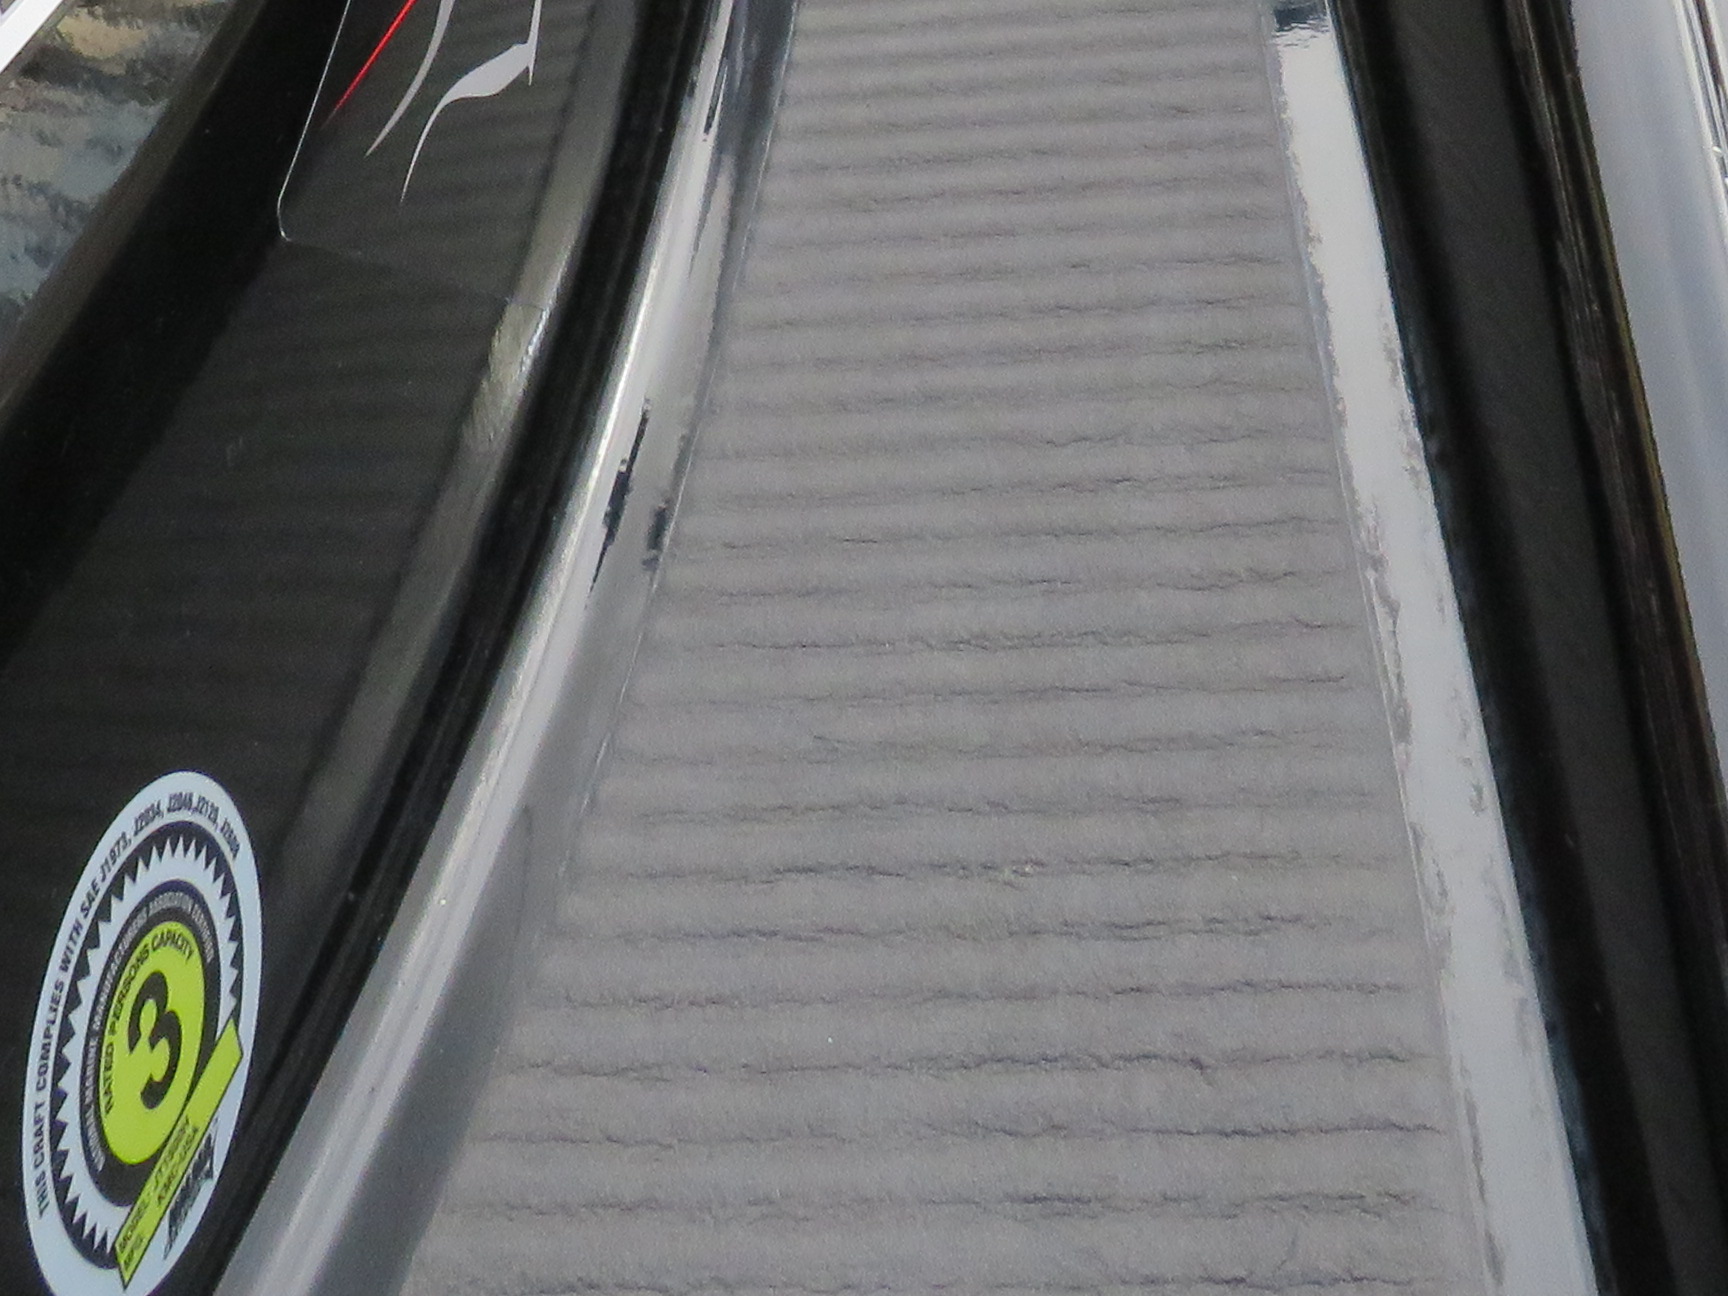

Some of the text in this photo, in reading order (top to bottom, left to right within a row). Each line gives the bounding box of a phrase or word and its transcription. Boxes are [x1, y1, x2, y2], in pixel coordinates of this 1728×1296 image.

[80, 879, 101, 919] SAE
[59, 917, 84, 974] WITH
[35, 979, 65, 1092] COMPLIES
[102, 928, 195, 1117] RATED PERSONS CAPACITY
[127, 969, 183, 1110] 3
[32, 1100, 46, 1169] CRAFT
[33, 1170, 51, 1220] THIS
